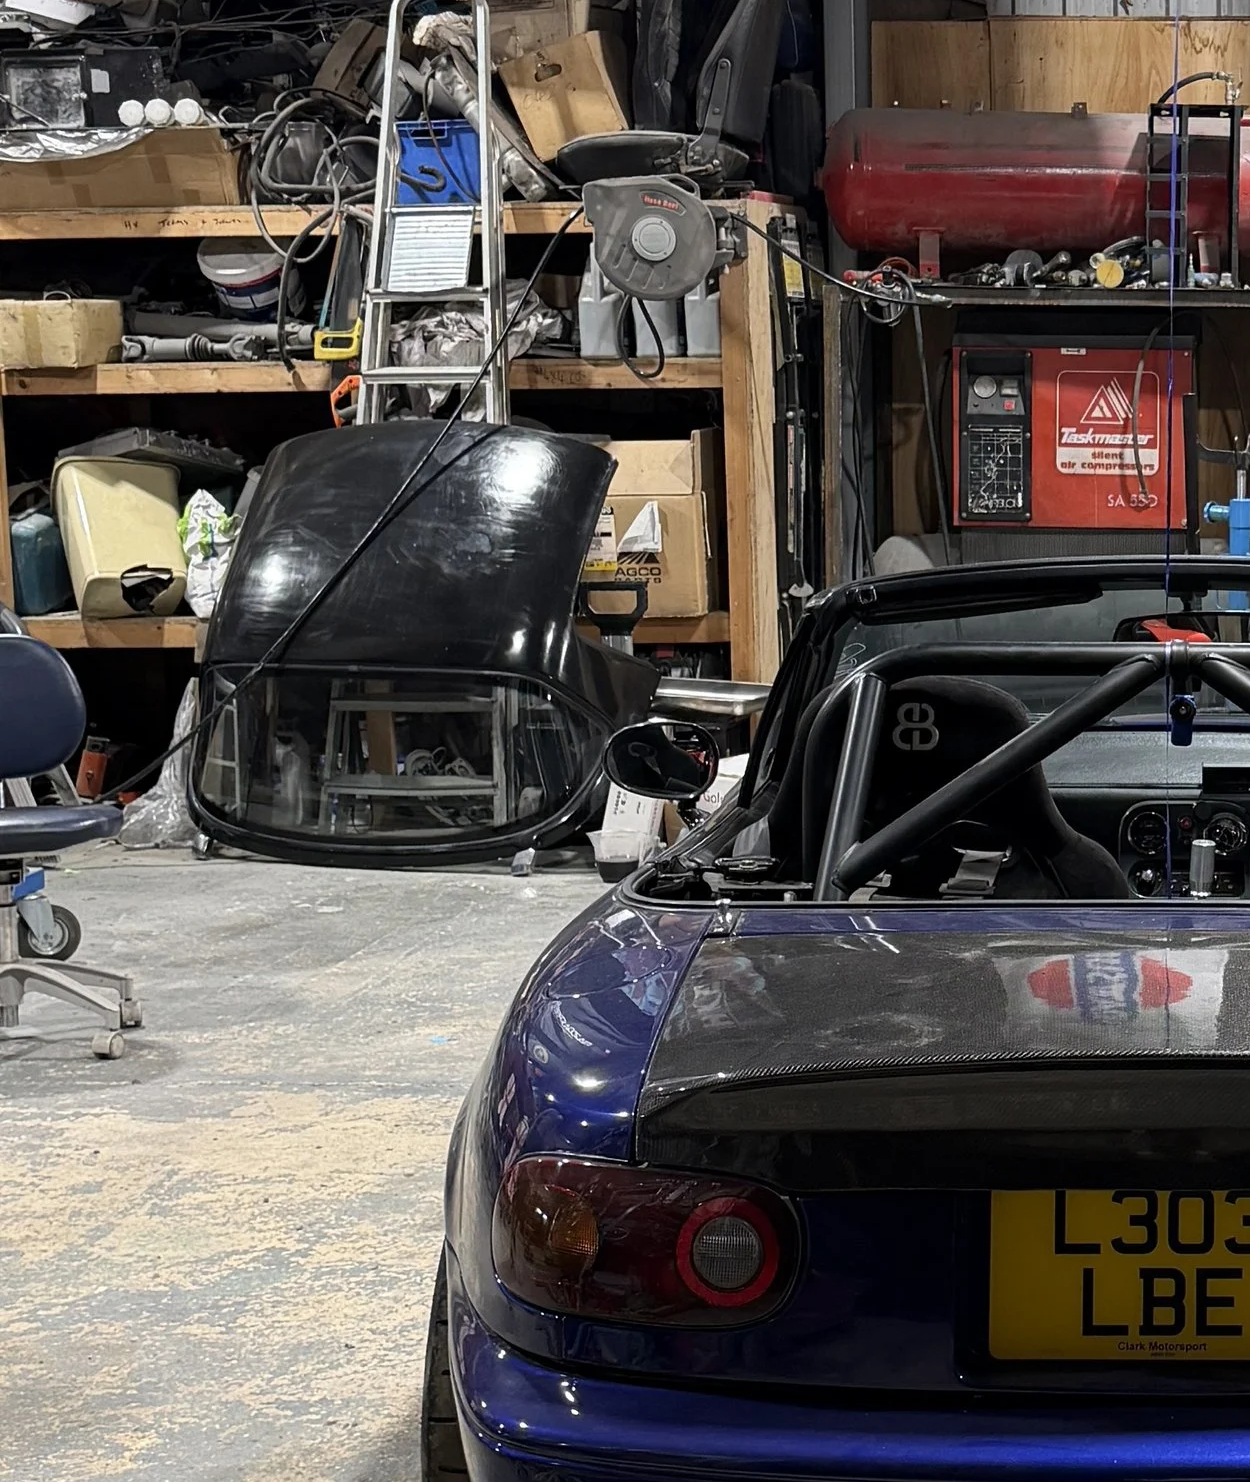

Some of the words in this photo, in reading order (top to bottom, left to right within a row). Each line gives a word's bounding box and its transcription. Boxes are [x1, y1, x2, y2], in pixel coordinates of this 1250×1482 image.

[1091, 450, 1125, 460] silent
[1060, 461, 1076, 470] air
[1080, 461, 1155, 472] compressrs
[1107, 493, 1126, 507] SA
[615, 567, 662, 577] AGCO
[1081, 1267, 1243, 1337] LBE
[1117, 1341, 1146, 1351] Clark
[1148, 1341, 1208, 1353] Motorsport
